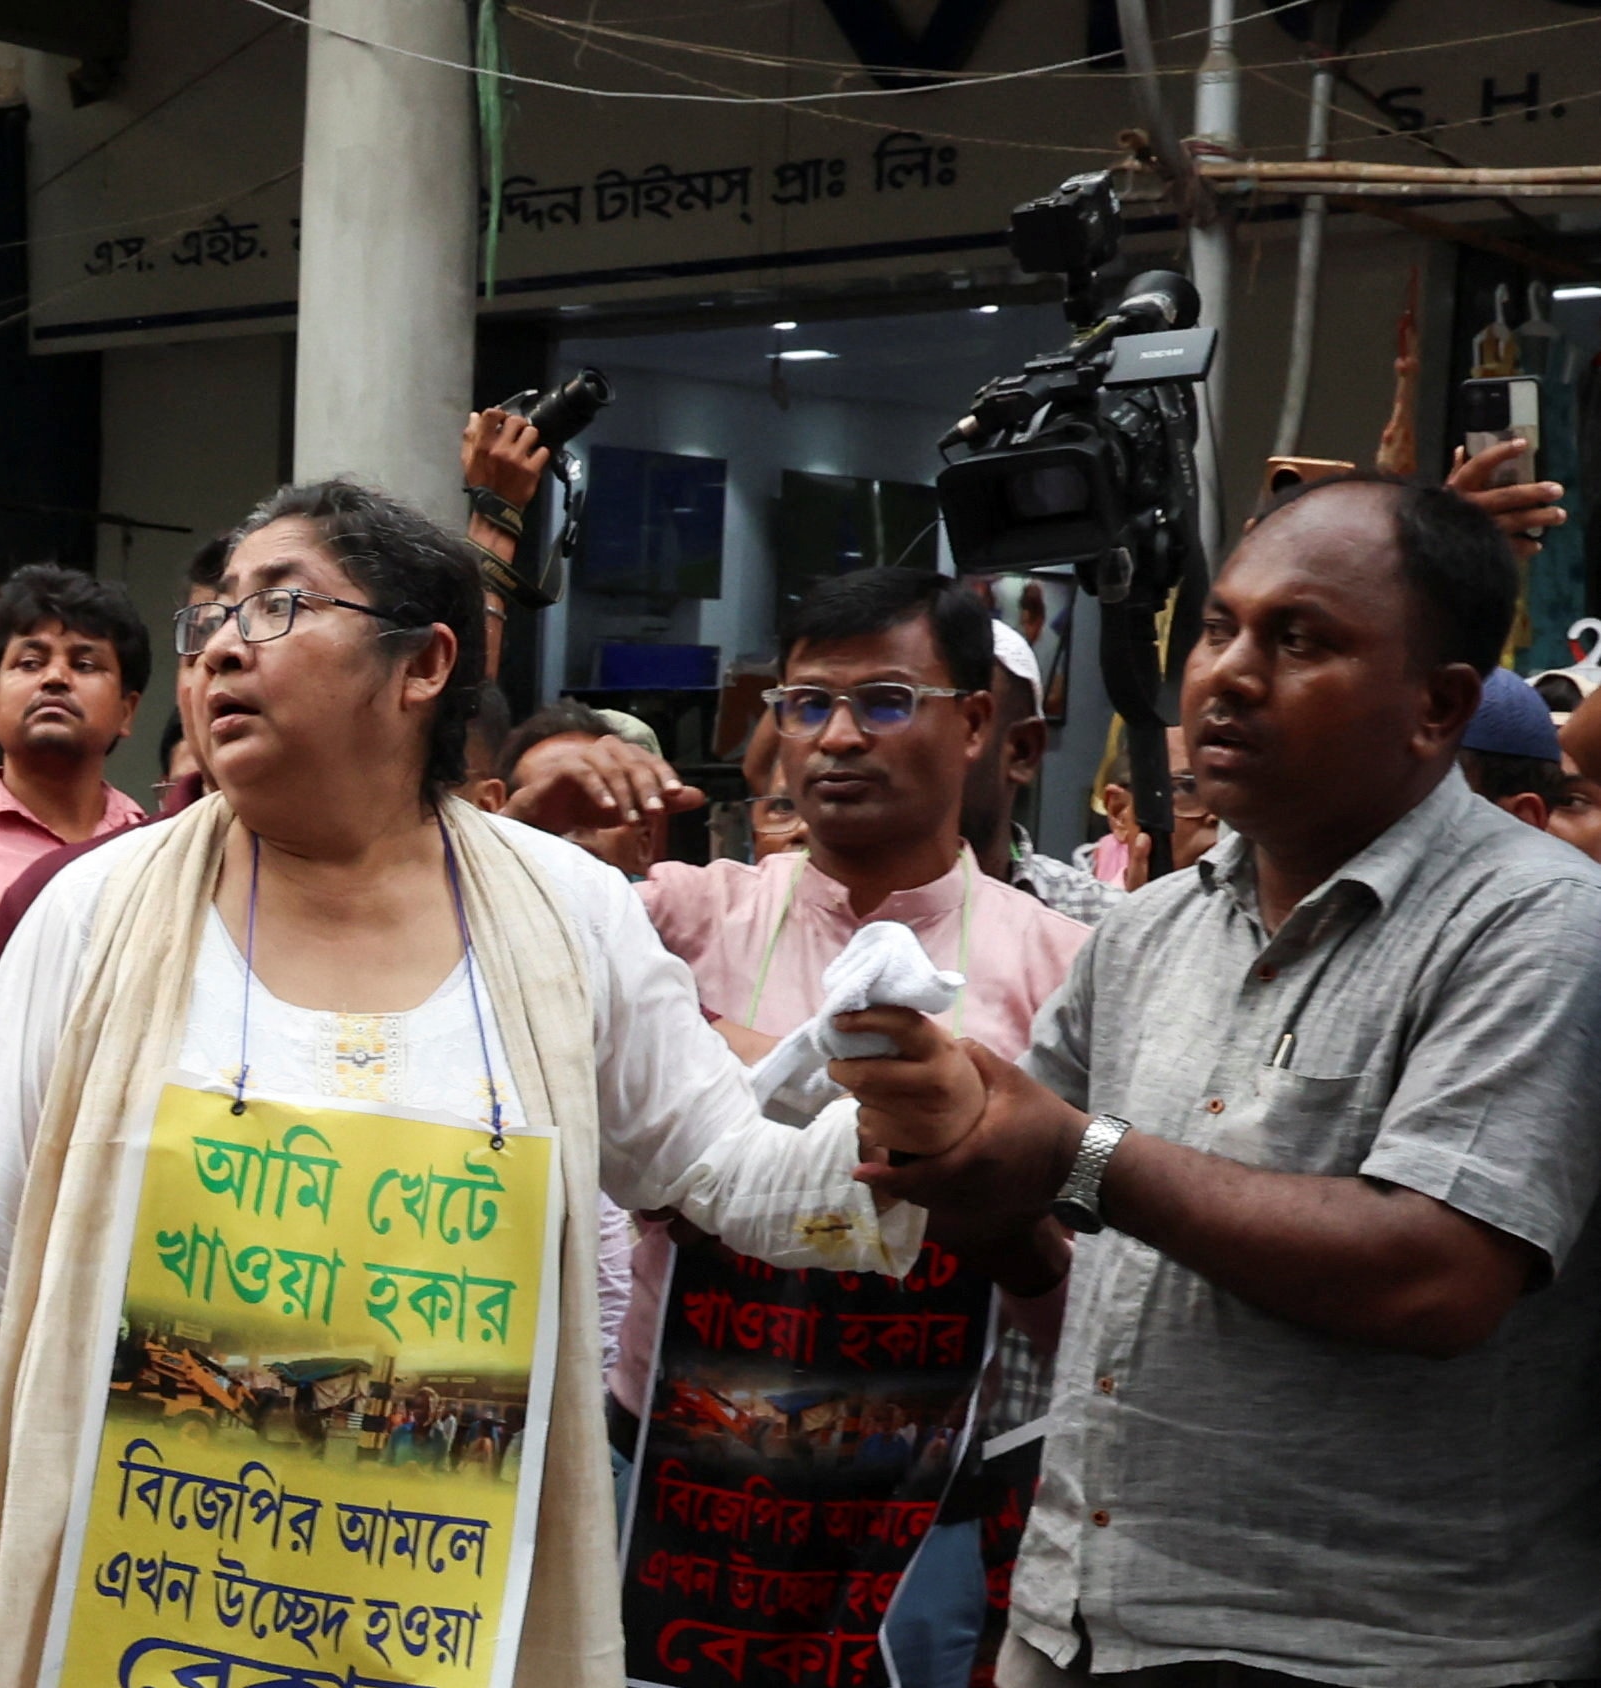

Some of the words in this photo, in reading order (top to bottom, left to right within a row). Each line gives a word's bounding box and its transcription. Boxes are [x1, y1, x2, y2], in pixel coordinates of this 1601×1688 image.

[1480, 71, 1568, 127] H.
[594, 163, 754, 225] টাইমস্
[771, 156, 847, 204] প্রাঃ
[871, 131, 959, 194] লিঃ
[191, 1124, 342, 1225] আমি
[367, 1151, 506, 1245] খেটে
[155, 1222, 346, 1327] খাওয়া
[362, 1261, 518, 1345] হকার
[681, 1289, 823, 1364] খাওয়া
[835, 1311, 971, 1371] হকার
[118, 1437, 323, 1557] বিজেপির
[335, 1500, 492, 1579] আমলে
[654, 1457, 812, 1545] বিজেপির
[95, 1549, 201, 1621] এখন
[212, 1547, 357, 1659] উচ্ছেদ
[363, 1598, 483, 1670] হওয়া
[636, 1549, 721, 1603] এখন
